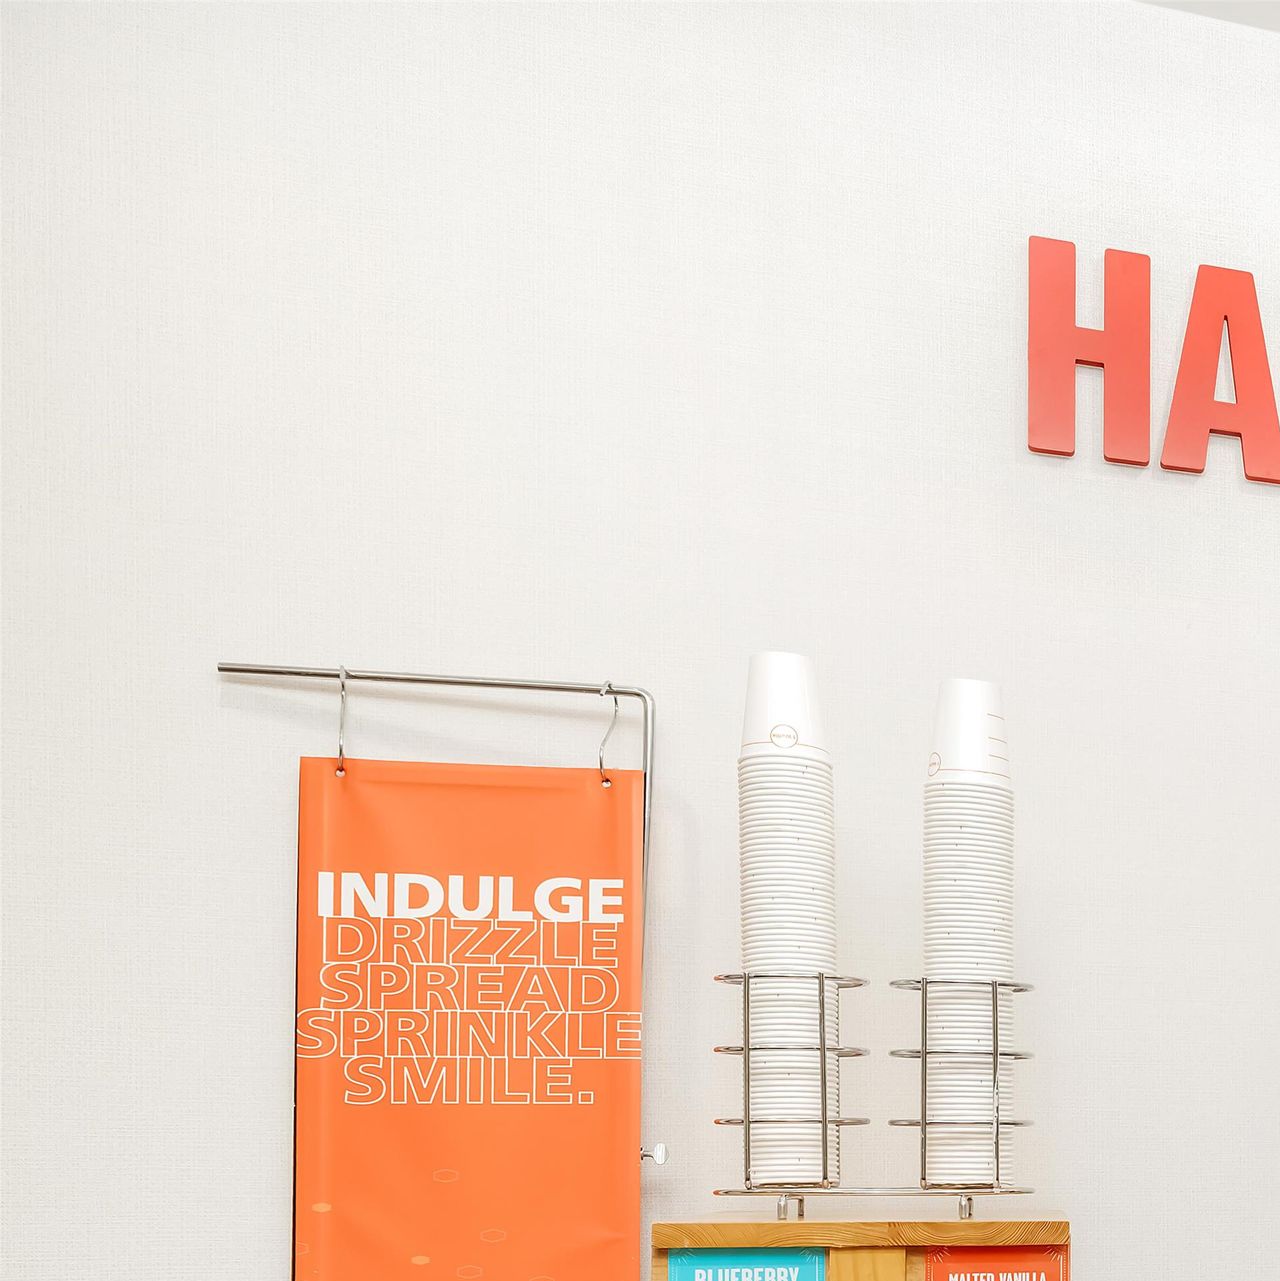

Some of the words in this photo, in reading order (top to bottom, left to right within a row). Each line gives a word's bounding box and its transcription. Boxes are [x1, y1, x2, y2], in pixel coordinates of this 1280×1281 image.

[317, 871, 625, 924] INDULGE
[322, 915, 619, 968] DRIZZLE
[318, 961, 621, 1014] SPREAD
[296, 1007, 642, 1060] SPRINKLE
[343, 1054, 595, 1105] SMILE.
